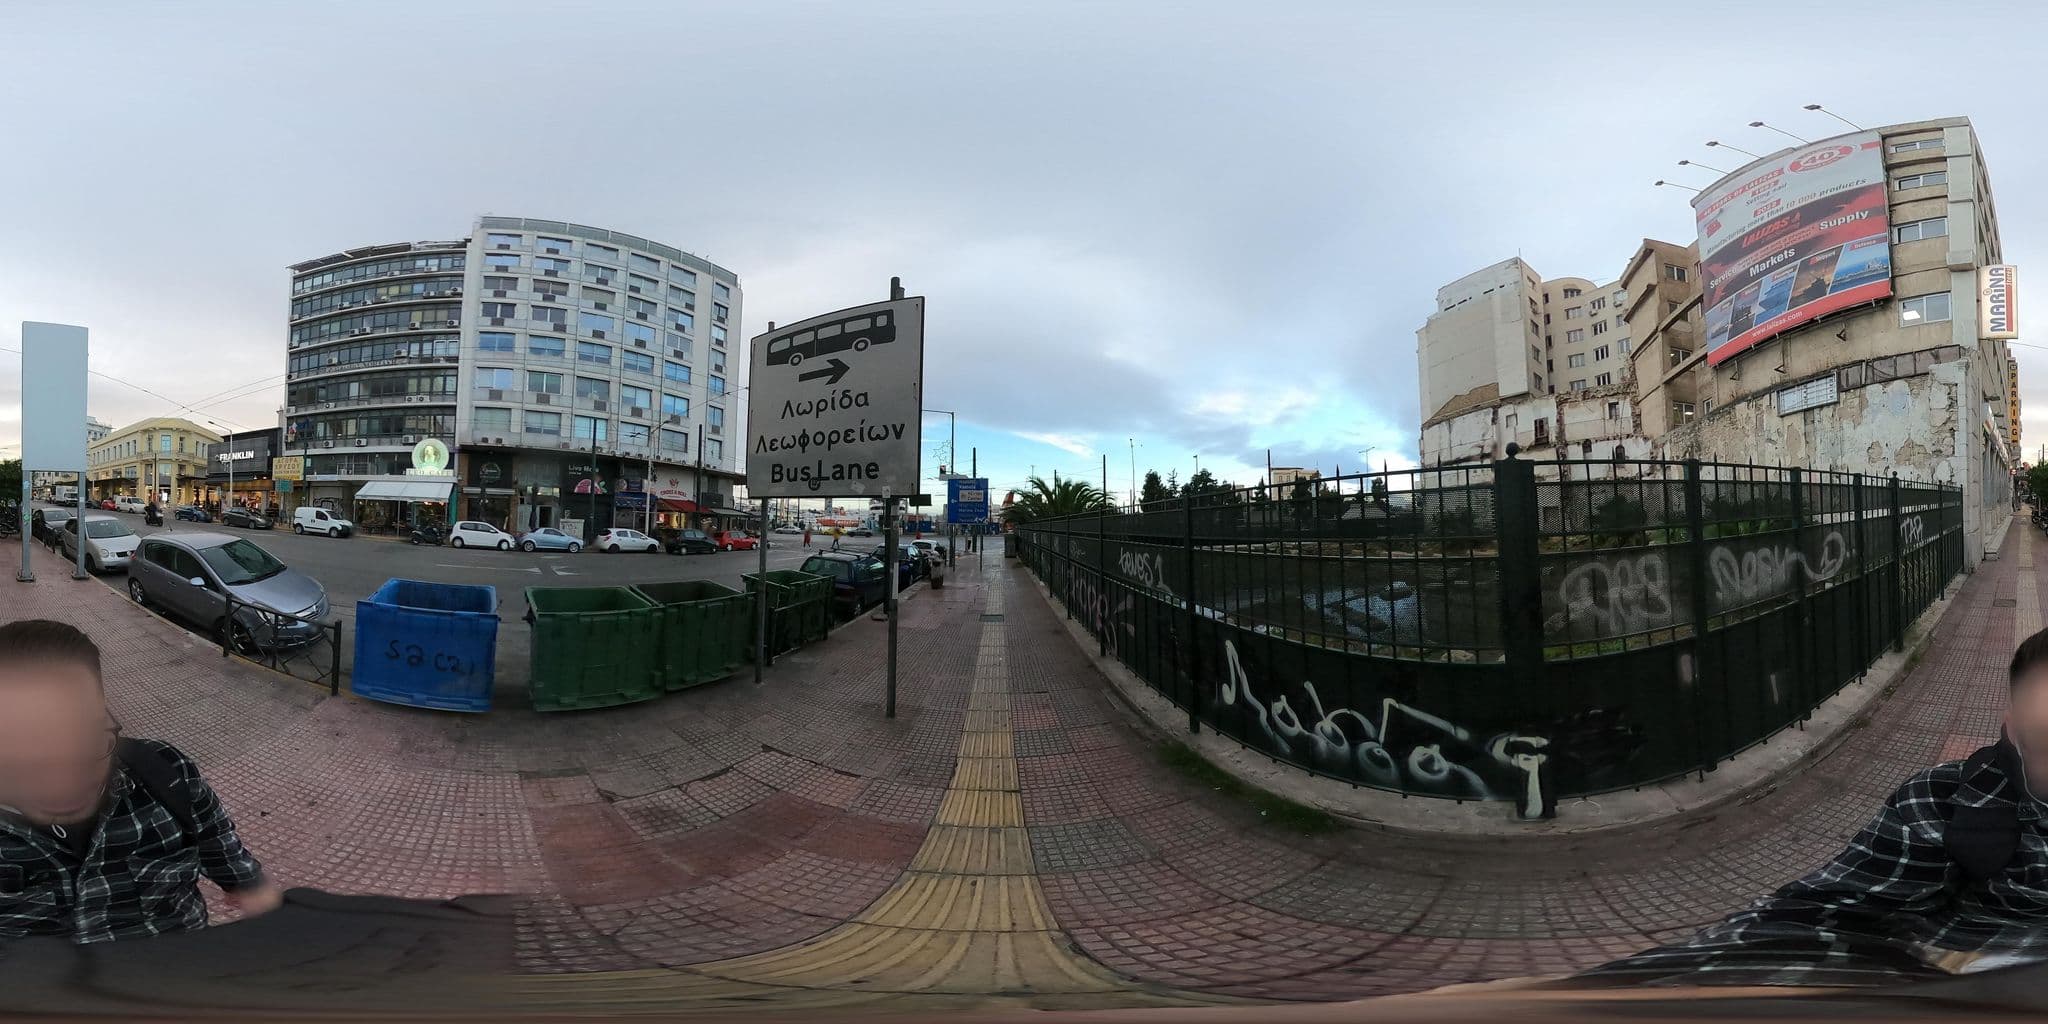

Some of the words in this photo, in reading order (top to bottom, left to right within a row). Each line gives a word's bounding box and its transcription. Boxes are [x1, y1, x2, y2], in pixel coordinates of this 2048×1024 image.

[1820, 178, 1867, 196] products
[1820, 210, 1869, 230] Supply
[1749, 248, 1796, 277] Markets
[1989, 267, 2005, 332] MARINA
[781, 389, 869, 419] Λωρίδα
[755, 419, 905, 454] Λεωφορείων
[219, 450, 254, 461] FRANKLIN
[771, 463, 811, 483] Bus
[817, 460, 880, 481] Lane
